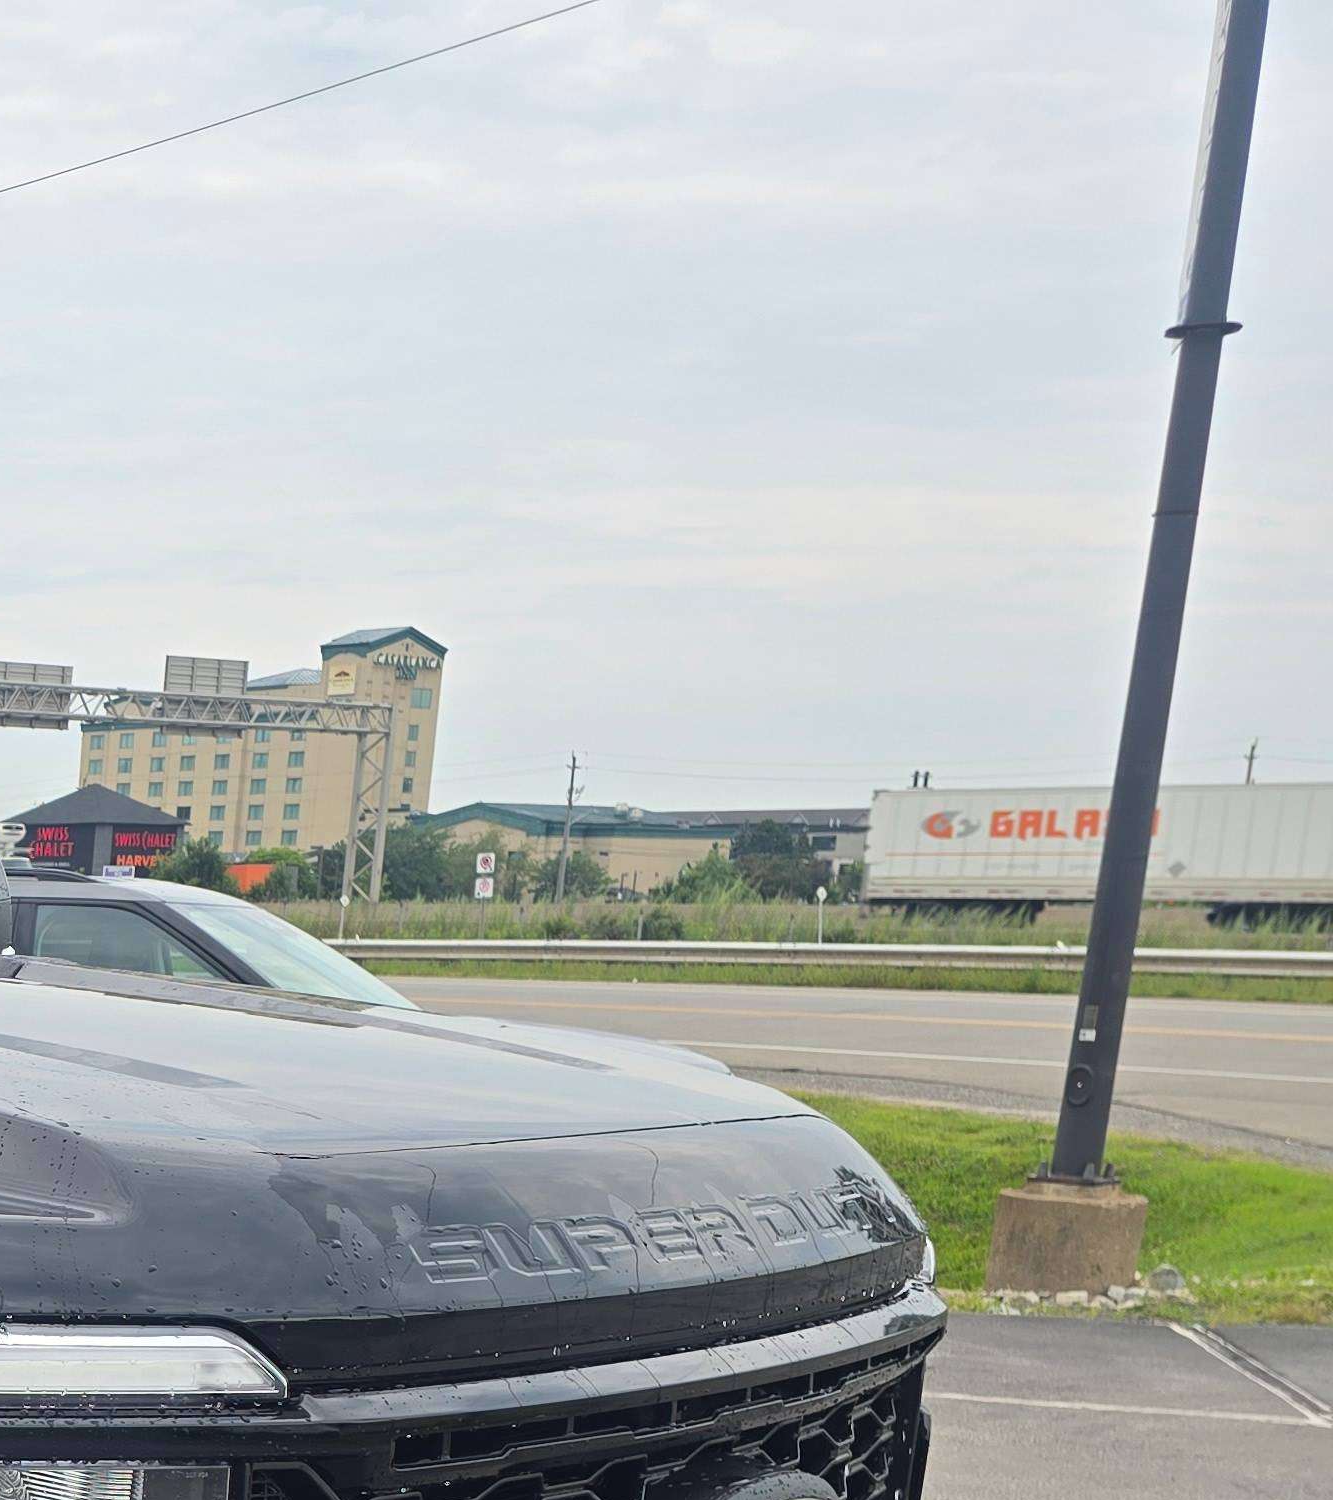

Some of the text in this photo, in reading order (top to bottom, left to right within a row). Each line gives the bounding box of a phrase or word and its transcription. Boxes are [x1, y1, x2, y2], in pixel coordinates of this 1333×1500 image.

[374, 653, 441, 669] CASABLANCA
[36, 826, 69, 841] SWISS
[989, 808, 1160, 841] GALA
[29, 840, 74, 859] CHALET
[115, 830, 176, 850] SWISS CHALET
[410, 1178, 899, 1284] SUPER DUTY
